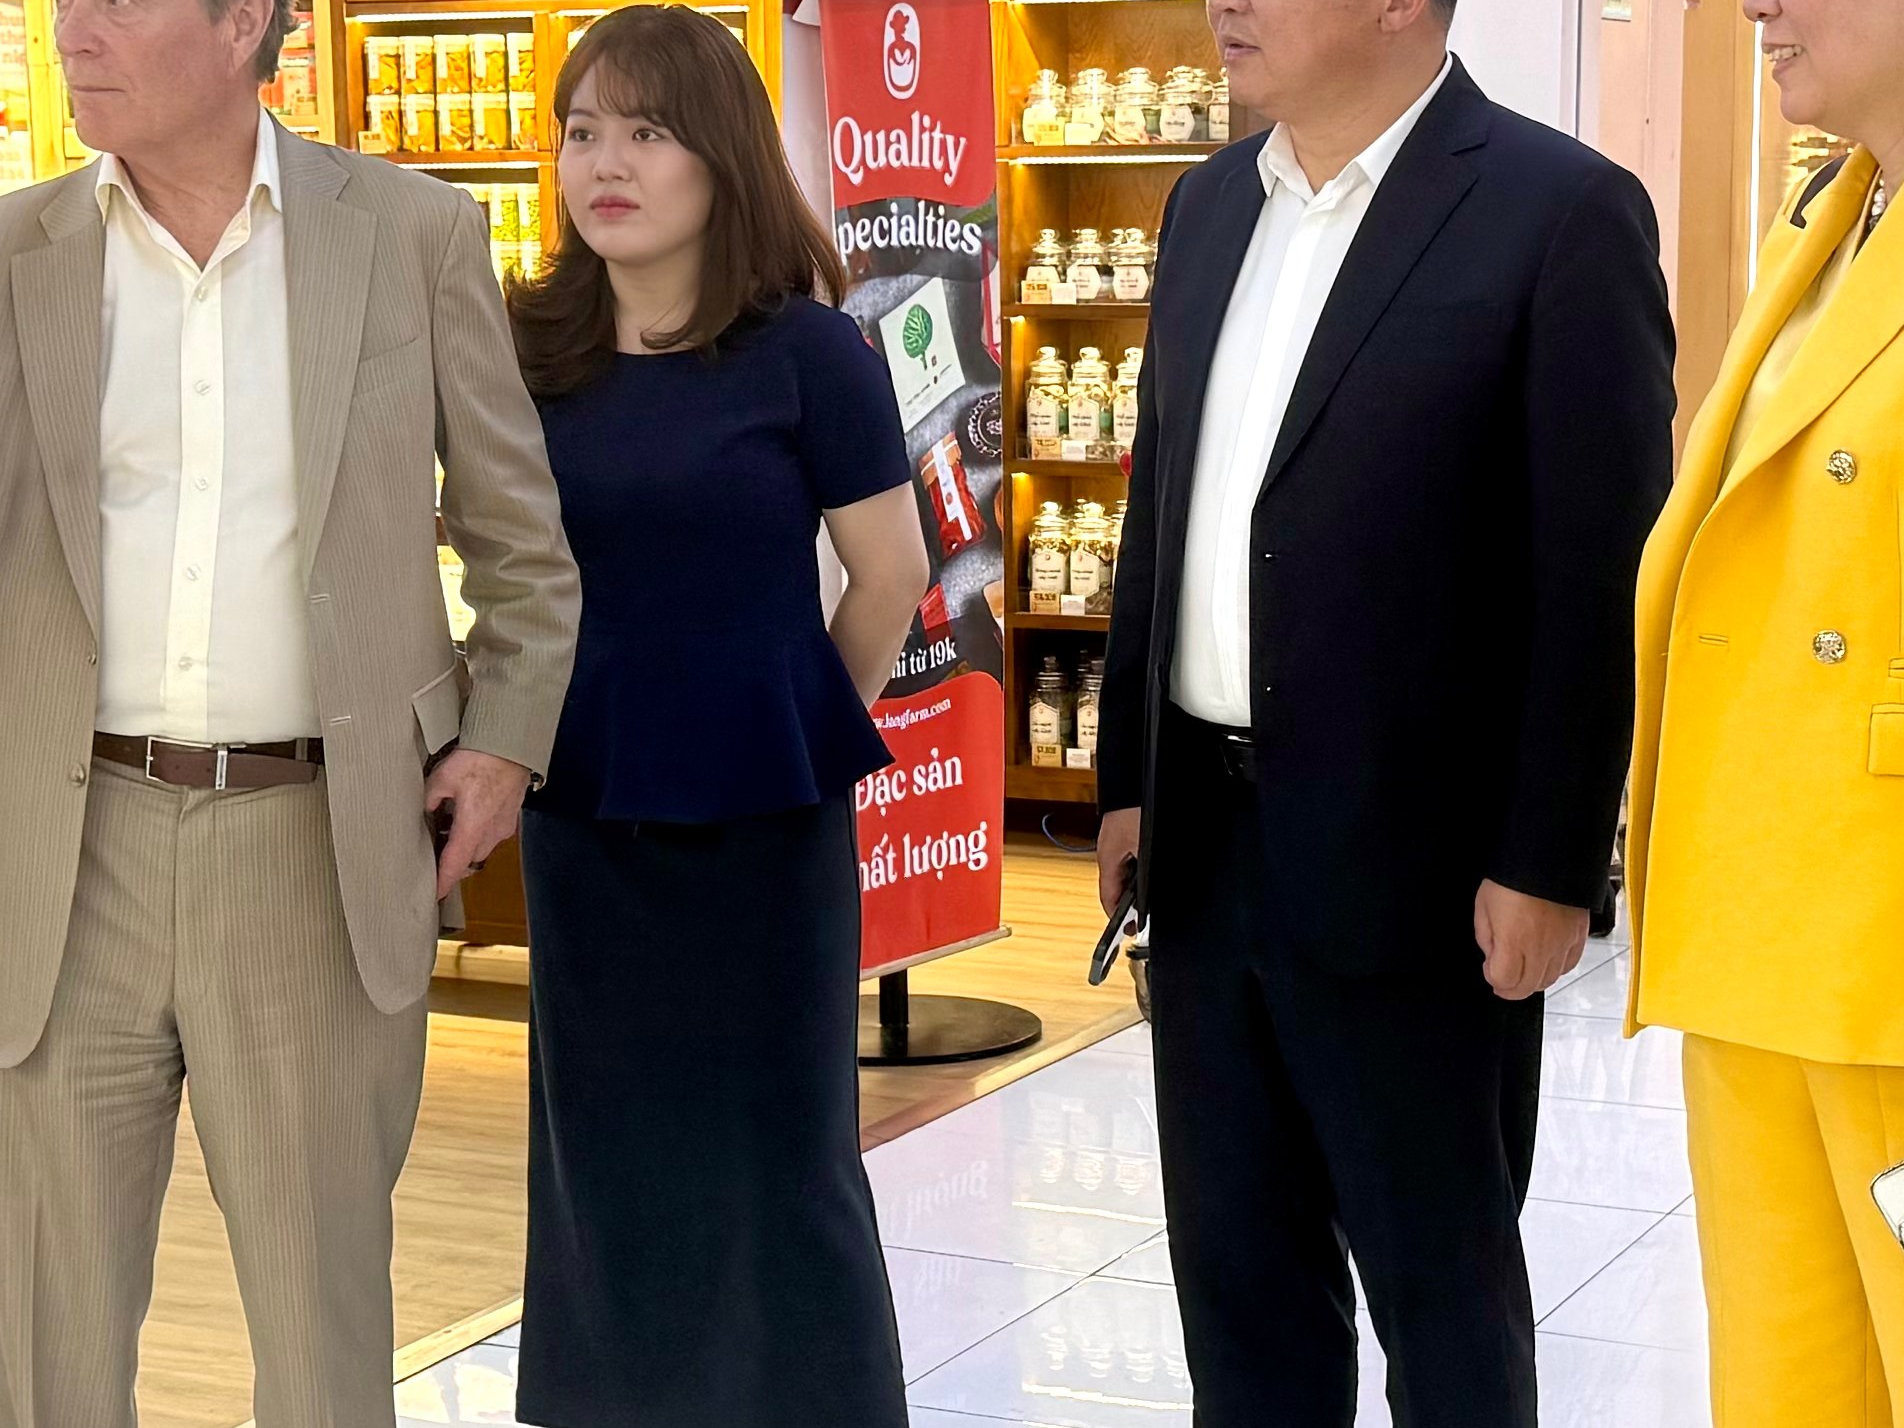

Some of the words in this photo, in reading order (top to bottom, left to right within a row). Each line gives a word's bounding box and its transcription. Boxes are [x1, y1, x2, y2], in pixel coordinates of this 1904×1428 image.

[833, 110, 968, 187] Quality
[838, 200, 983, 266] pecialties
[909, 647, 927, 675] từ
[929, 636, 957, 669] 19k
[912, 747, 964, 796] sản
[903, 821, 989, 881] lượng
